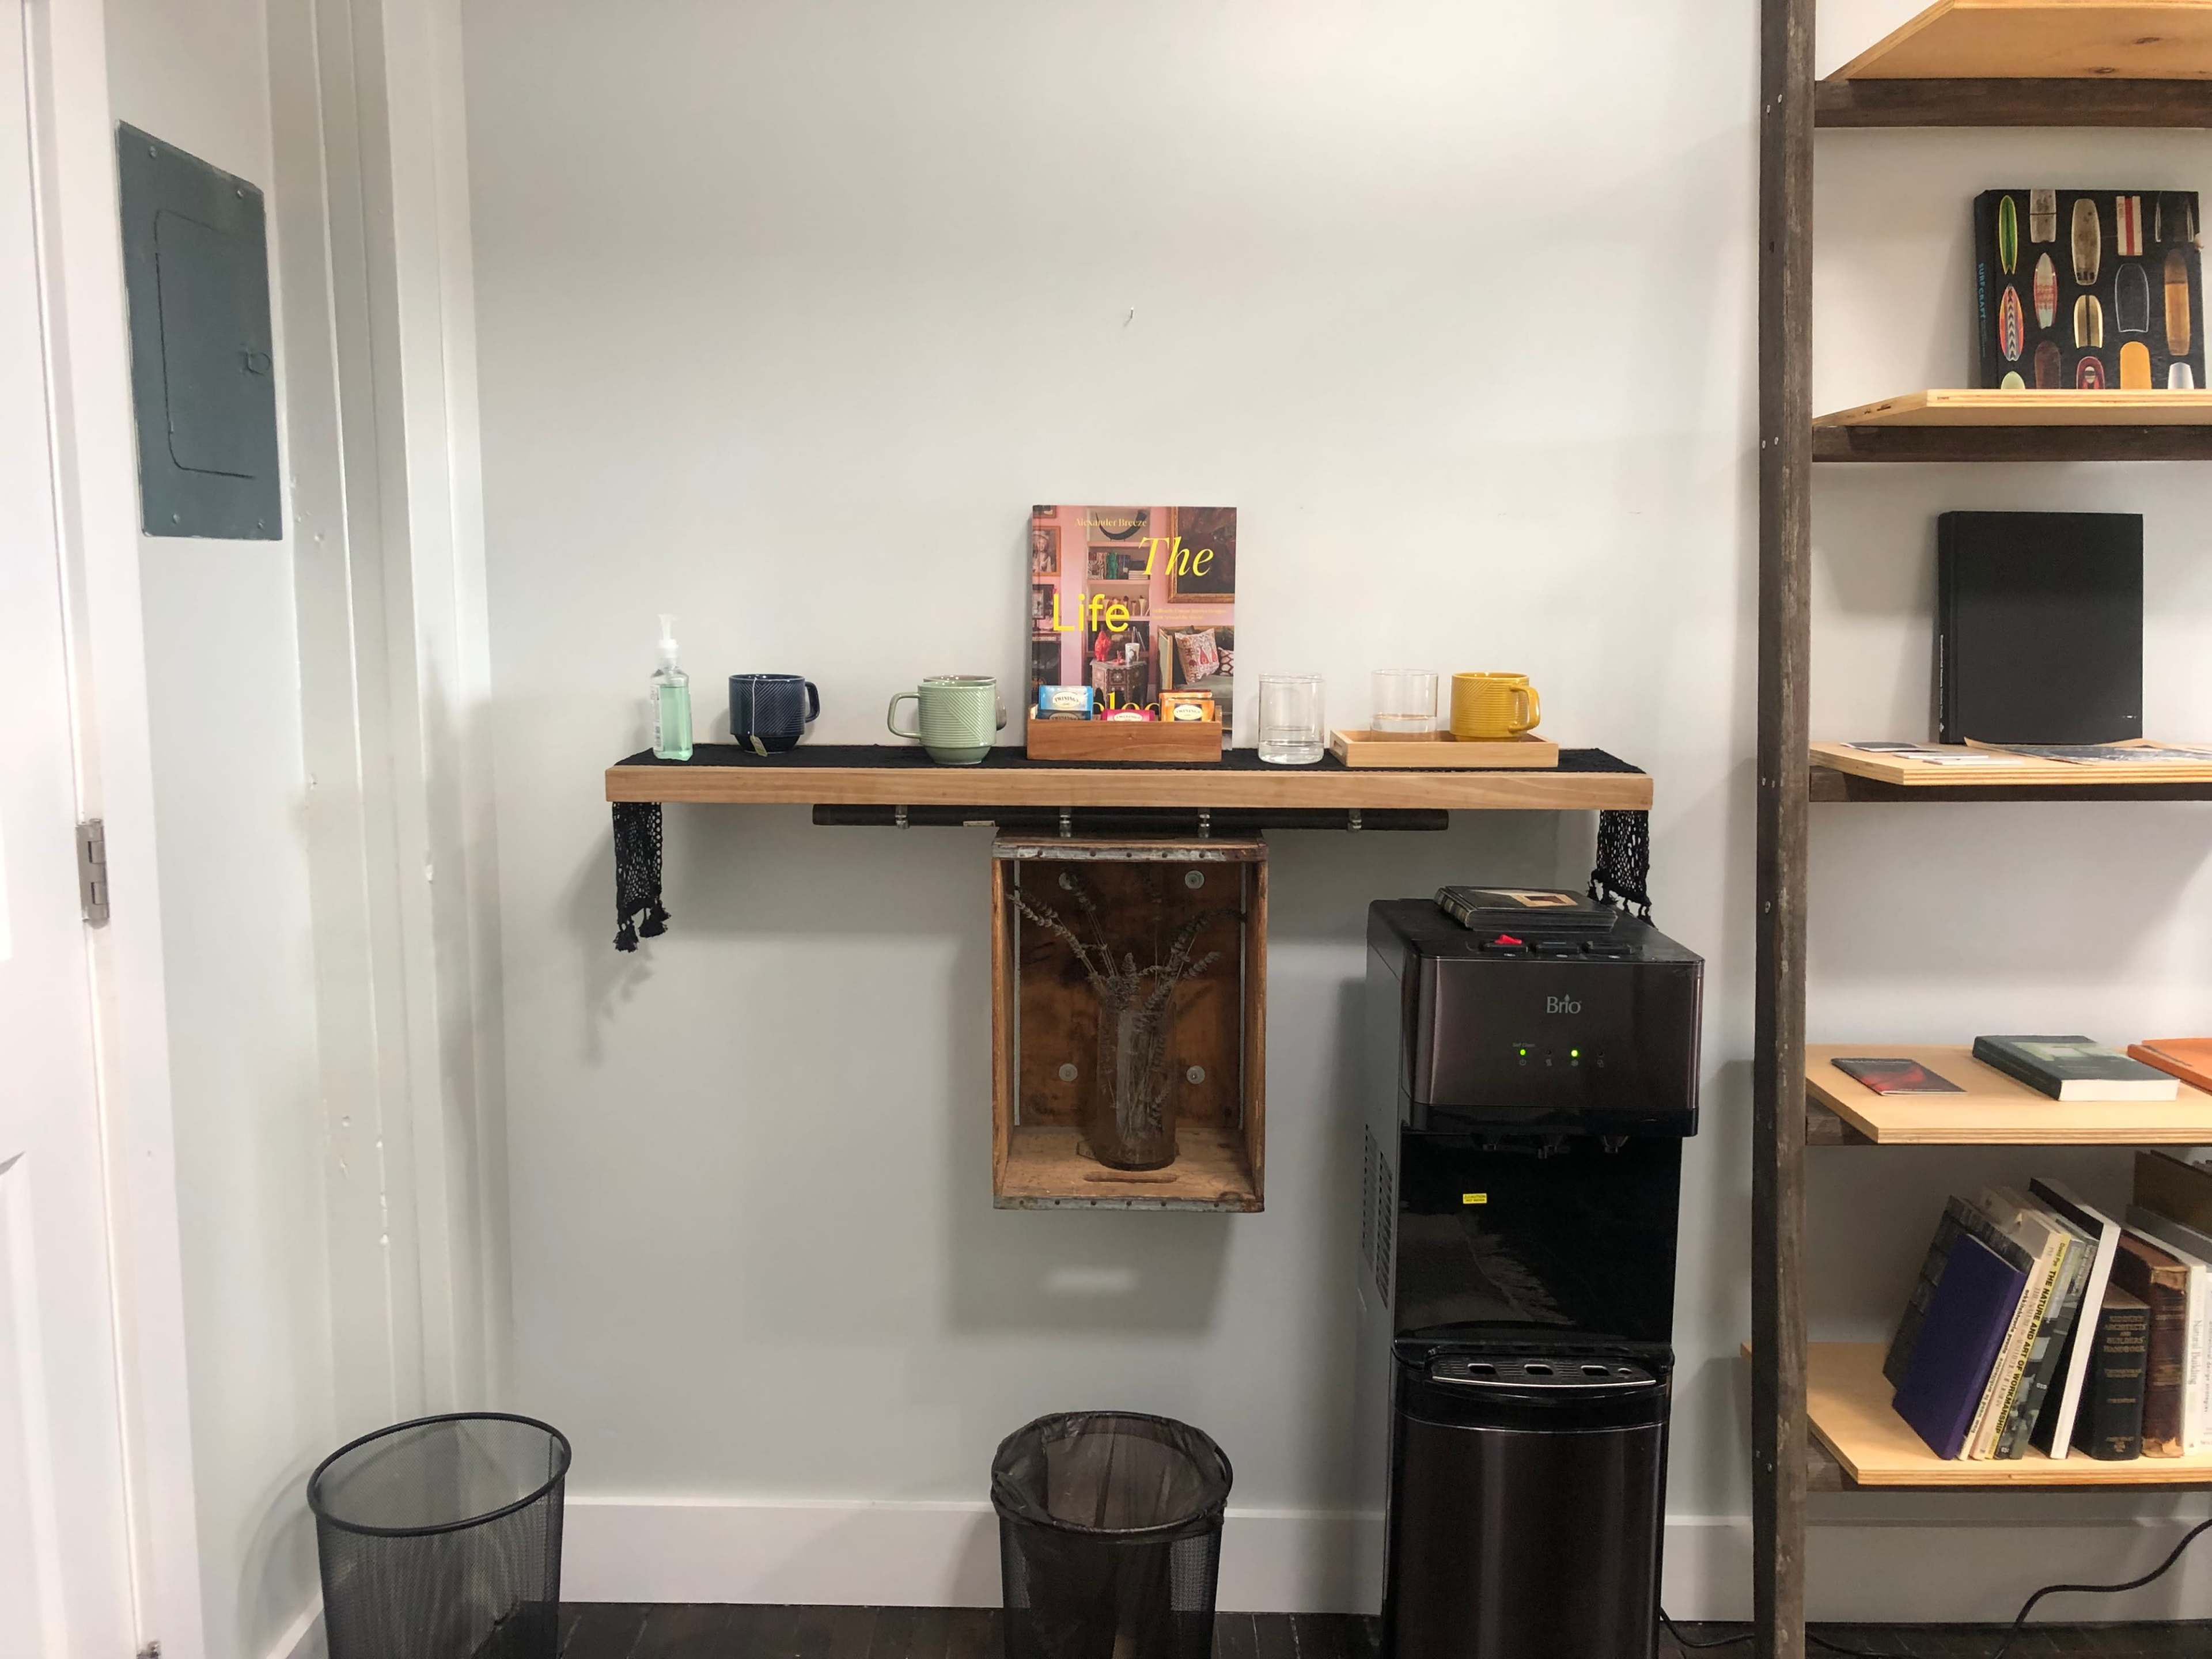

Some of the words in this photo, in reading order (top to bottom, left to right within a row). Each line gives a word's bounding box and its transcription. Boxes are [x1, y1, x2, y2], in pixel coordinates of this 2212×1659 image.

[1075, 518, 1116, 527] Alexander
[1119, 518, 1147, 527] Breeze
[1138, 536, 1214, 577] The
[1053, 593, 1130, 632] Life
[1546, 994, 1581, 1014] Brio
[2045, 1271, 2056, 1286] THE
[2033, 1289, 2050, 1321] NATURE
[2027, 1323, 2037, 1340] AND
[2020, 1341, 2031, 1358] ART
[2017, 1360, 2025, 1371] OF
[2188, 1351, 2200, 1384] Building
[1995, 1373, 2020, 1434] WORKMANSHIP
